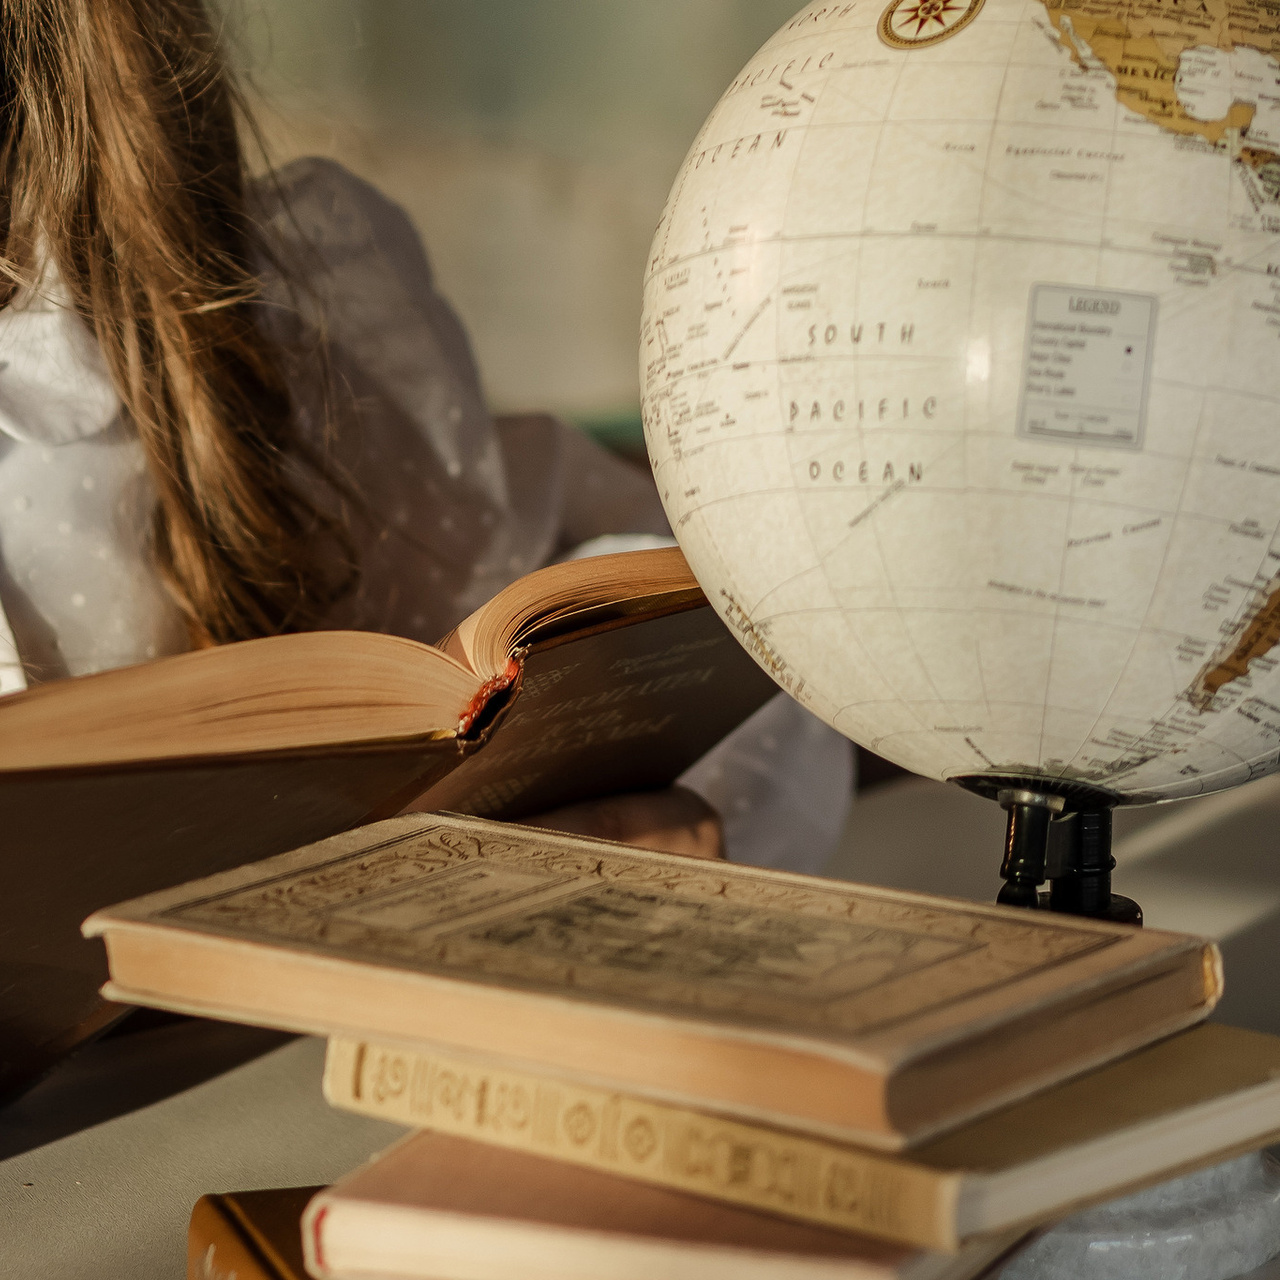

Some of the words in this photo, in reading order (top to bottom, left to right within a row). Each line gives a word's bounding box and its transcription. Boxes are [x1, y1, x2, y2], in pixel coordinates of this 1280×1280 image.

[786, 2, 857, 31] NORTH
[725, 52, 834, 98] PACIFIC
[695, 130, 787, 169] OCEAN
[1068, 296, 1122, 315] LEGEND
[806, 323, 916, 346] SOUTH
[789, 397, 937, 421] PACIFIC
[809, 461, 922, 483] OCEAN
